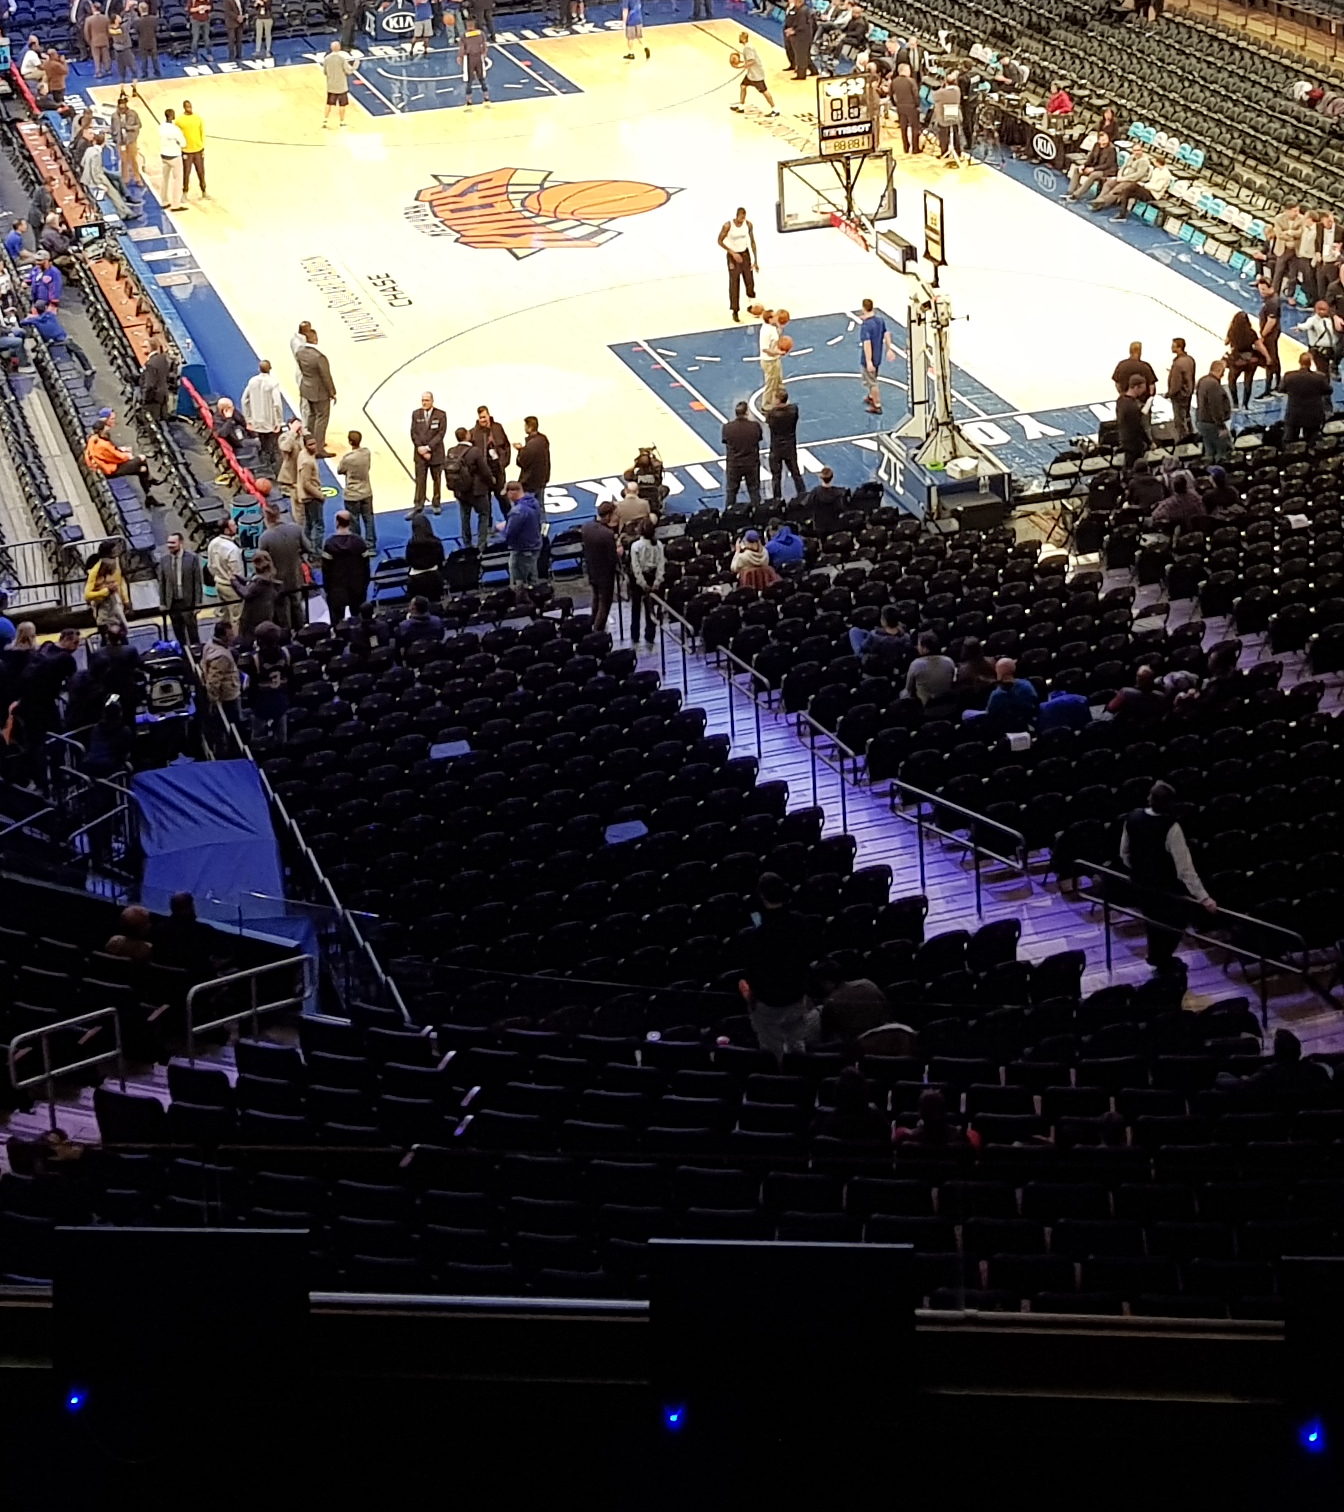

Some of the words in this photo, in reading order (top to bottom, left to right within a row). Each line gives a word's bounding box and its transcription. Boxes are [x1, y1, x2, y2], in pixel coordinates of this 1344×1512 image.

[388, 18, 413, 28] KIA
[184, 58, 275, 77] NEW
[837, 123, 871, 136] TISSOT
[1037, 137, 1053, 156] KIA
[367, 272, 412, 307] CHASE
[878, 445, 905, 495] ZTE
